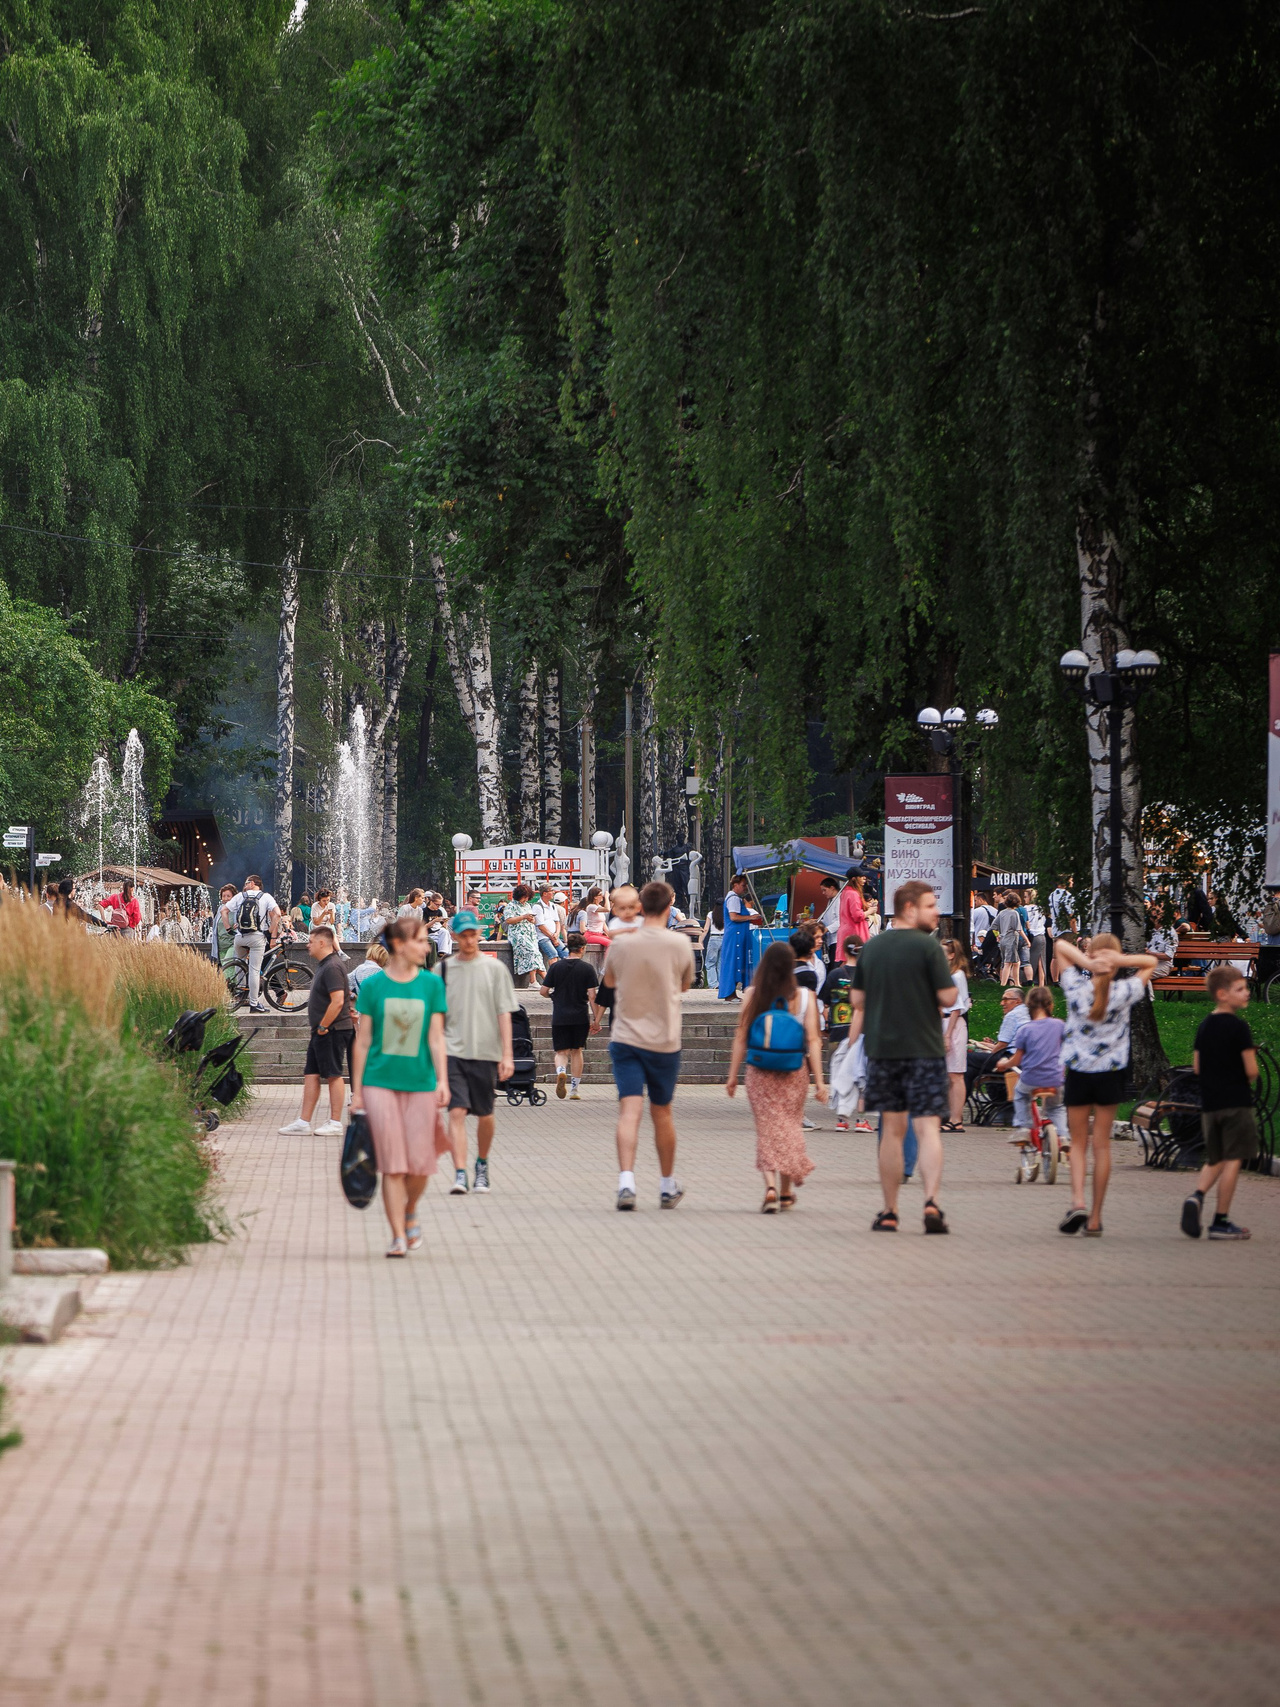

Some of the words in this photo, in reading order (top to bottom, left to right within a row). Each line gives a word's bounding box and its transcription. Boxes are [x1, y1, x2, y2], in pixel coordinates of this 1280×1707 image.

[505, 849, 556, 859] ПАРК
[891, 850, 920, 859] ВИНО
[896, 859, 952, 868] КУЛЬТУРА
[887, 869, 937, 879] МУЗЫКА
